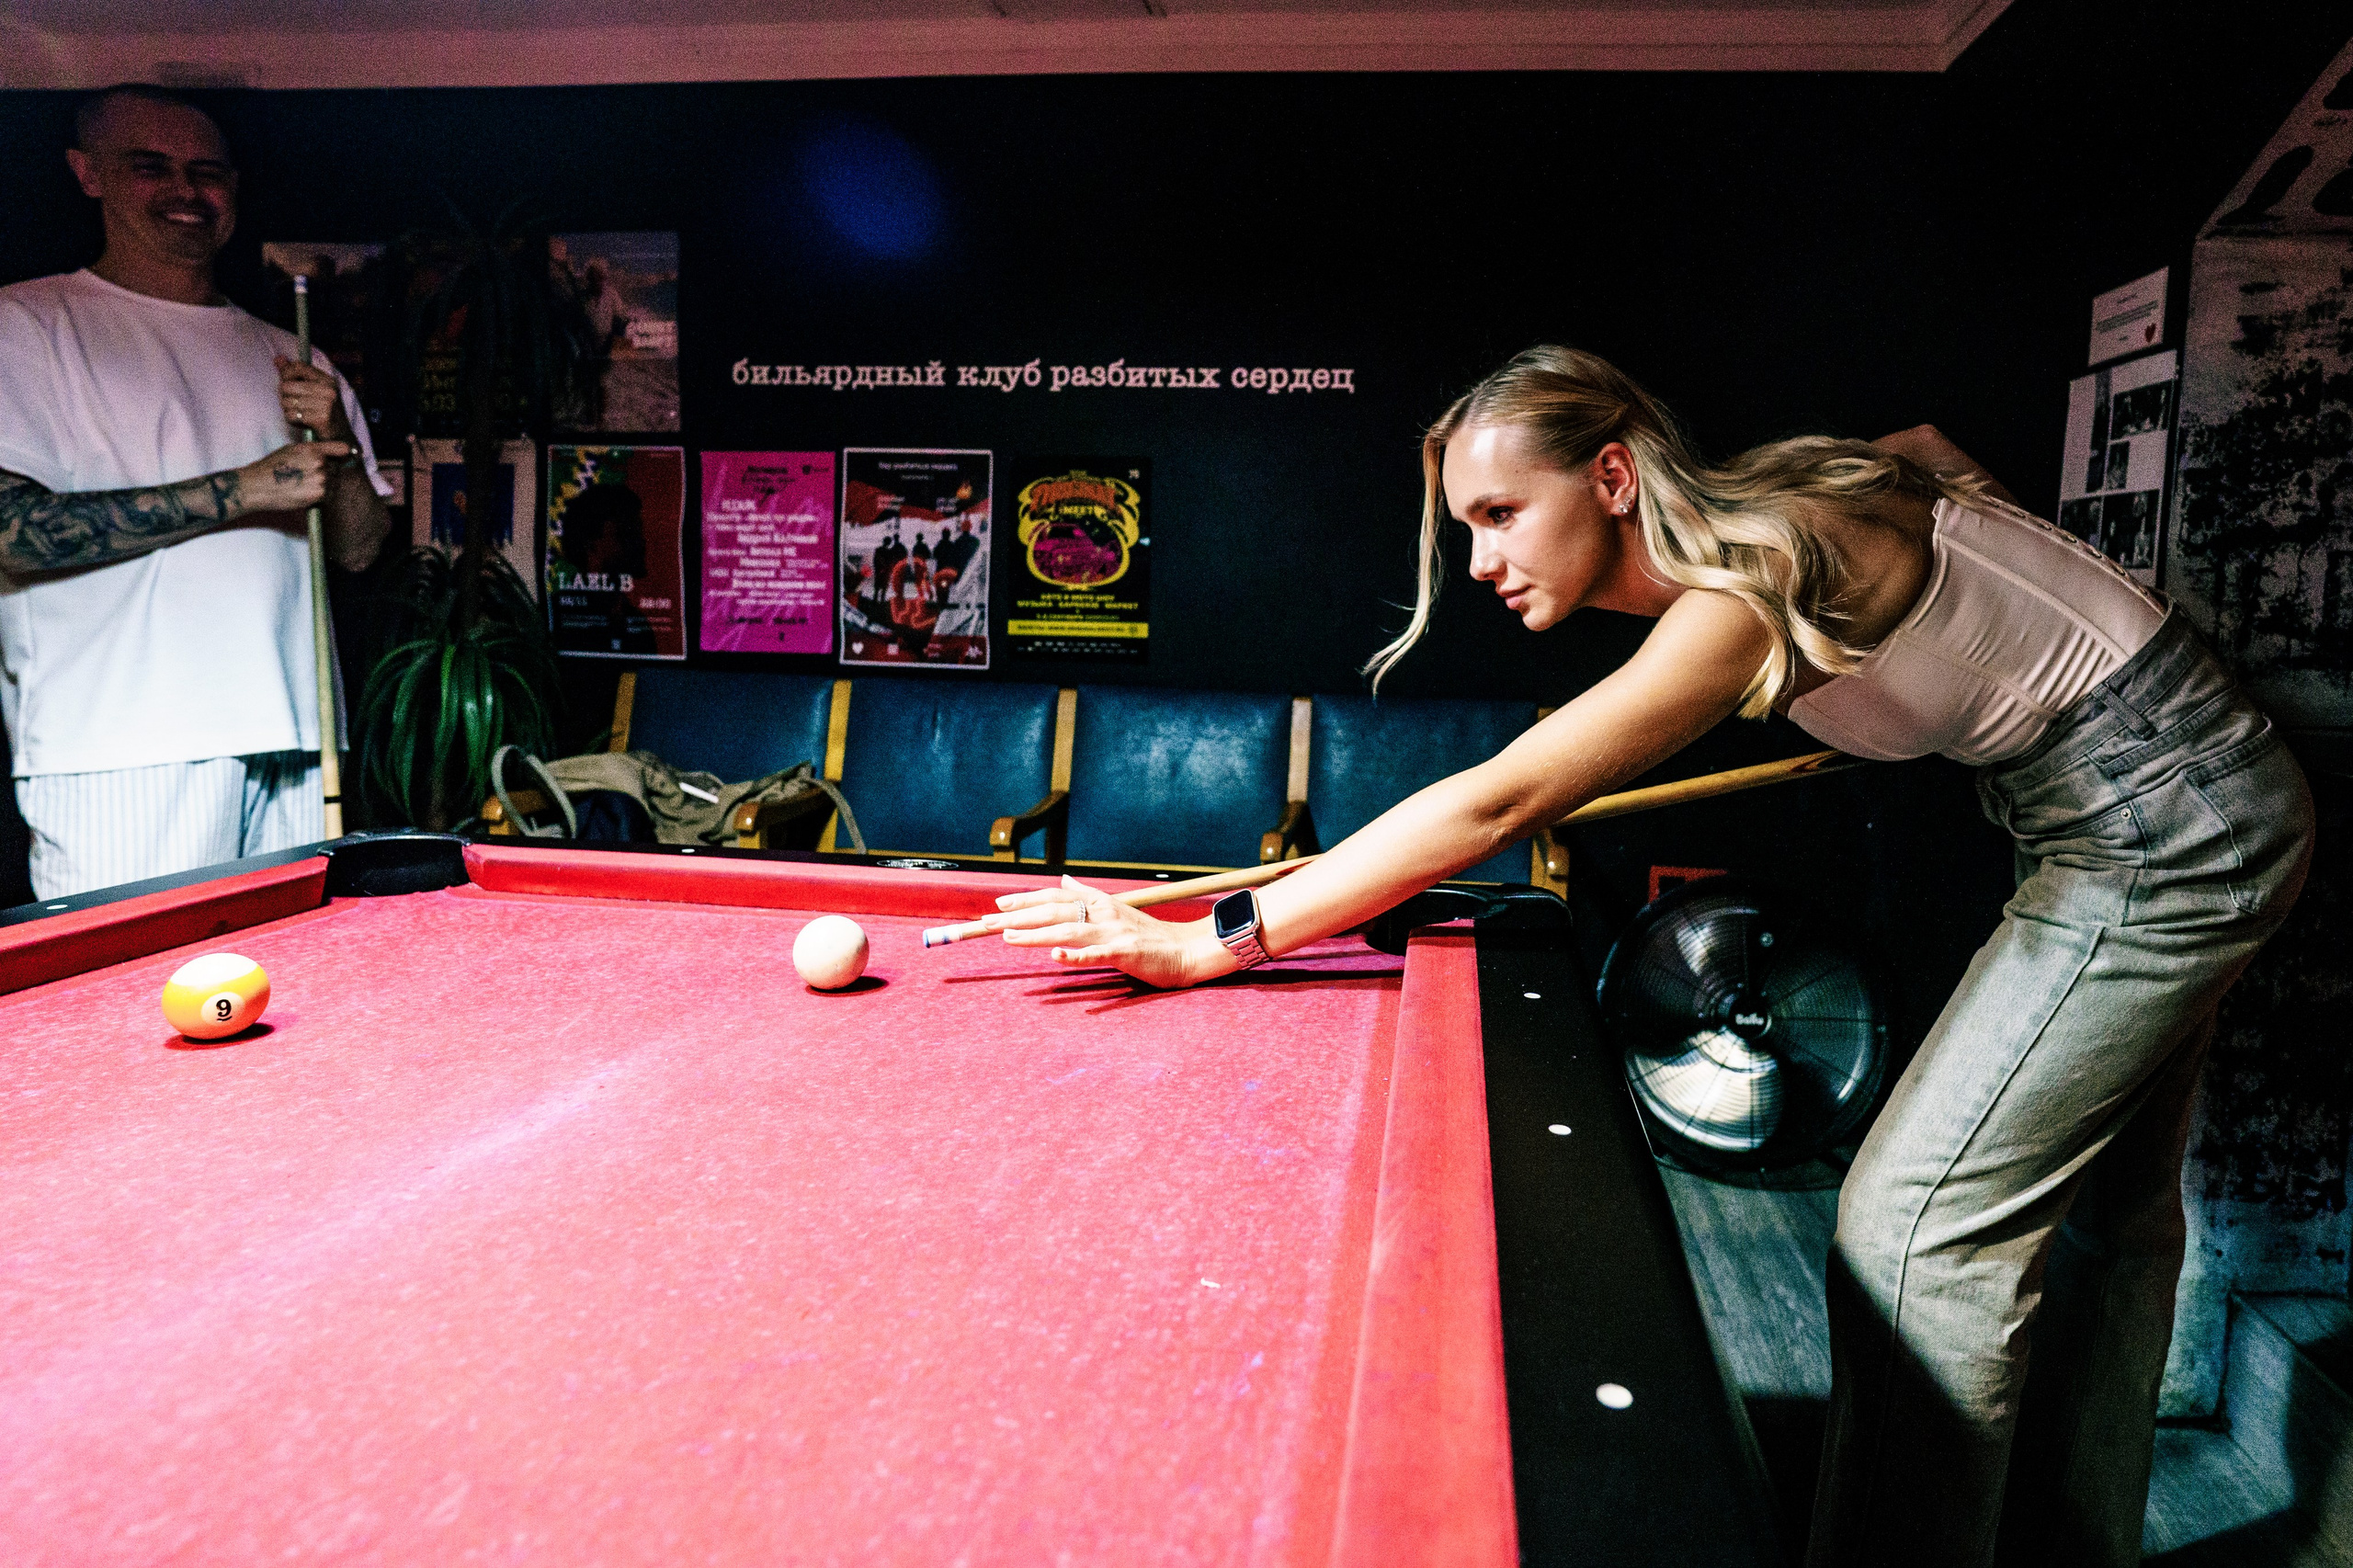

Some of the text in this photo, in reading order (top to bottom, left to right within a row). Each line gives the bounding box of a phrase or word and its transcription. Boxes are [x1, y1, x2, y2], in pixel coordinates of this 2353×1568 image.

[732, 358, 1355, 394] бильярдный клуб разбитых сердец
[216, 998, 233, 1017] 9
